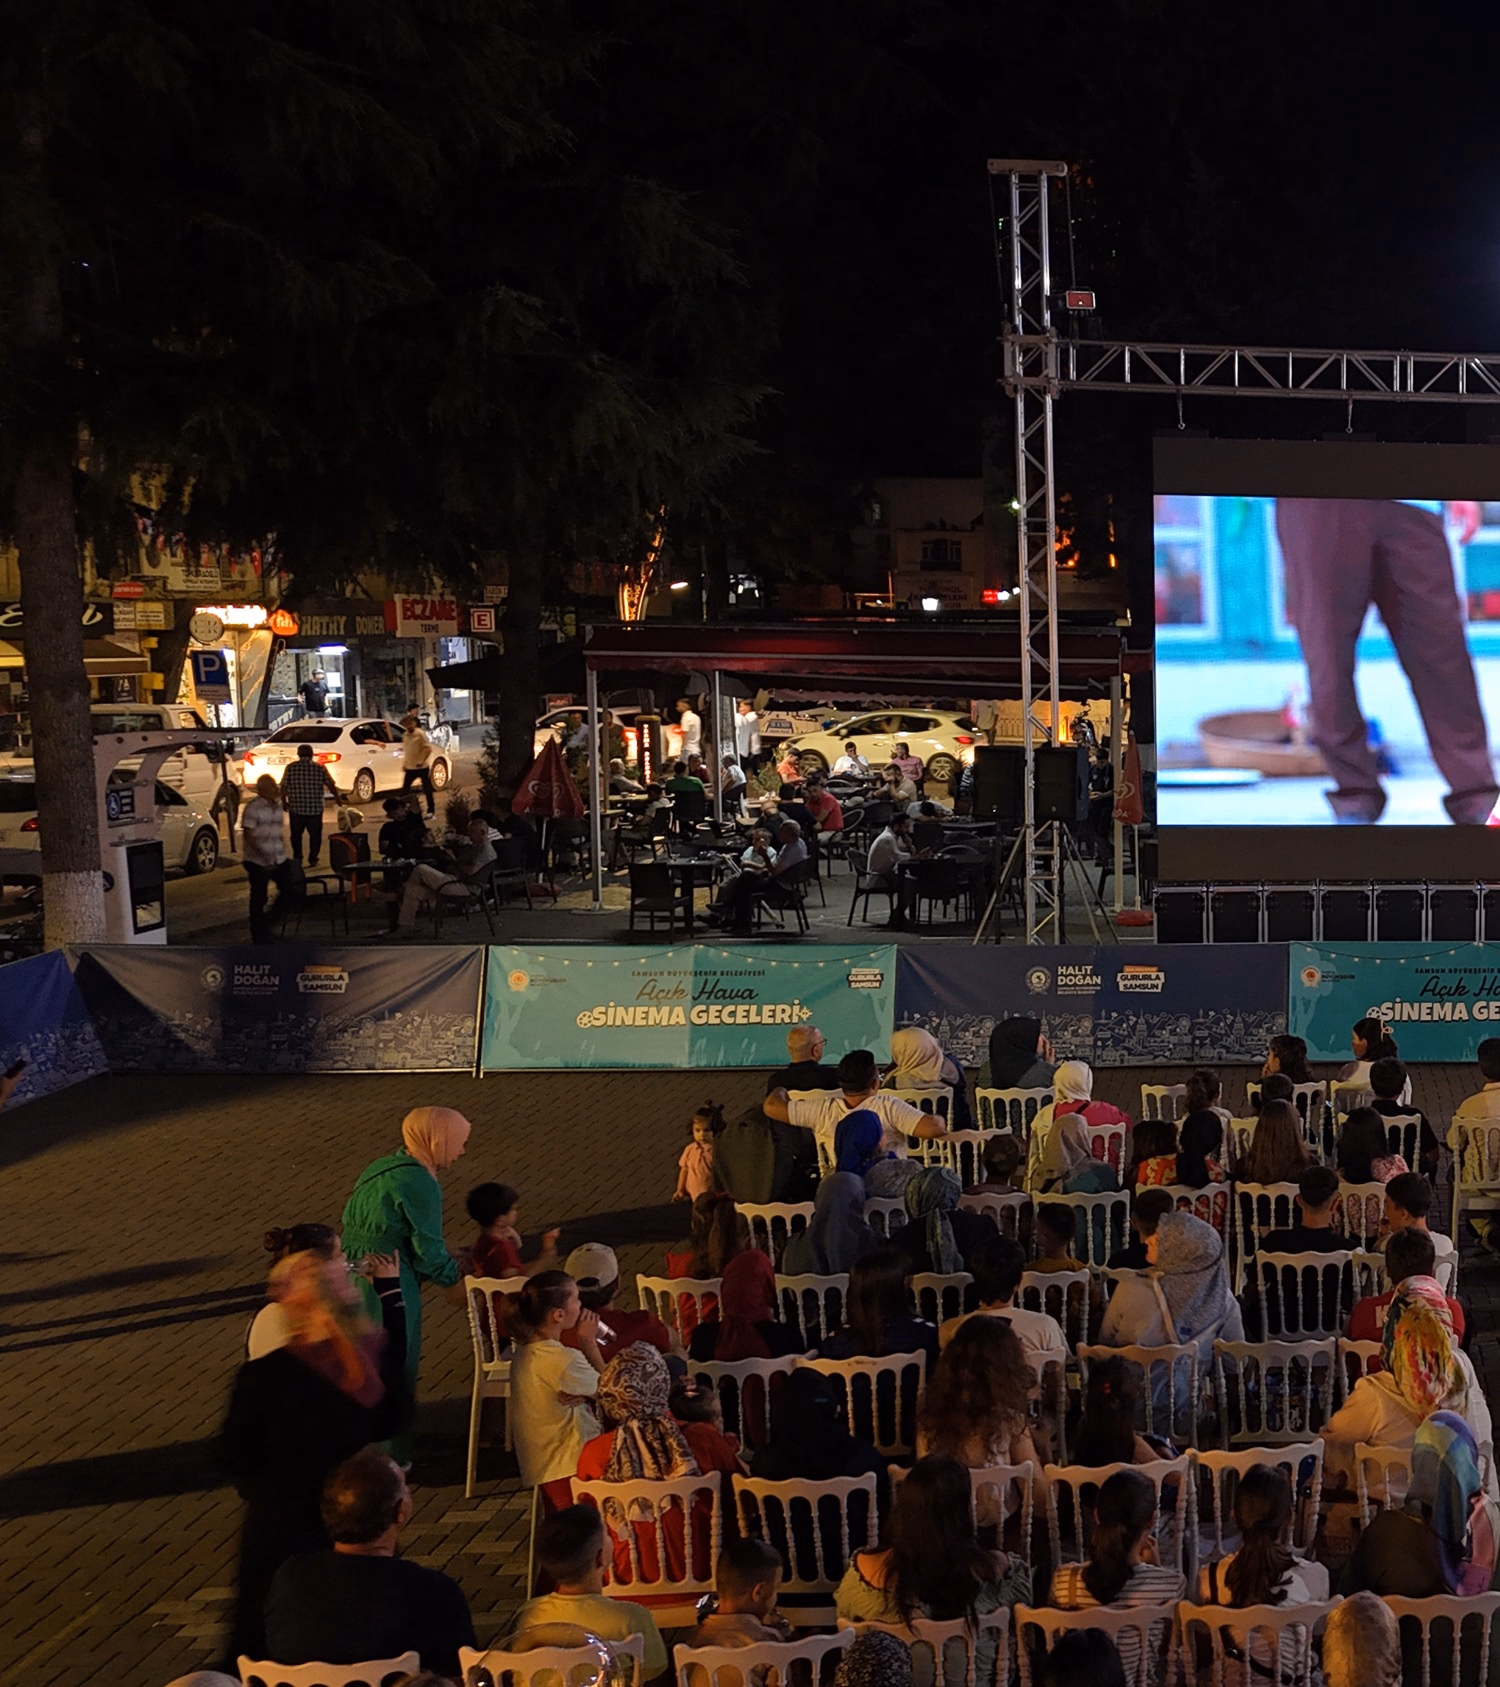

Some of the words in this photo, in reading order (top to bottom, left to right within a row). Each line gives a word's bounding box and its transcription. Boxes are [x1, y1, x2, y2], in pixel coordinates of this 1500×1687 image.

[402, 599, 456, 621] ECZANE
[478, 615, 488, 627] E
[421, 624, 440, 634] TERME
[198, 654, 220, 682] P
[1058, 965, 1094, 975] HALİT
[234, 975, 281, 985] DOĞAN
[300, 974, 345, 983] GURURLA
[1057, 974, 1101, 984] DOĞAN
[1120, 974, 1161, 982] GURURLA
[303, 984, 343, 992] SAMSUN
[635, 978, 690, 1006] Açık
[692, 978, 759, 1001] Hava
[1420, 975, 1471, 1002] Açık
[592, 1001, 688, 1027] SİNEMA
[690, 999, 802, 1026] GECELERİ
[1380, 997, 1469, 1023] SİNEMA
